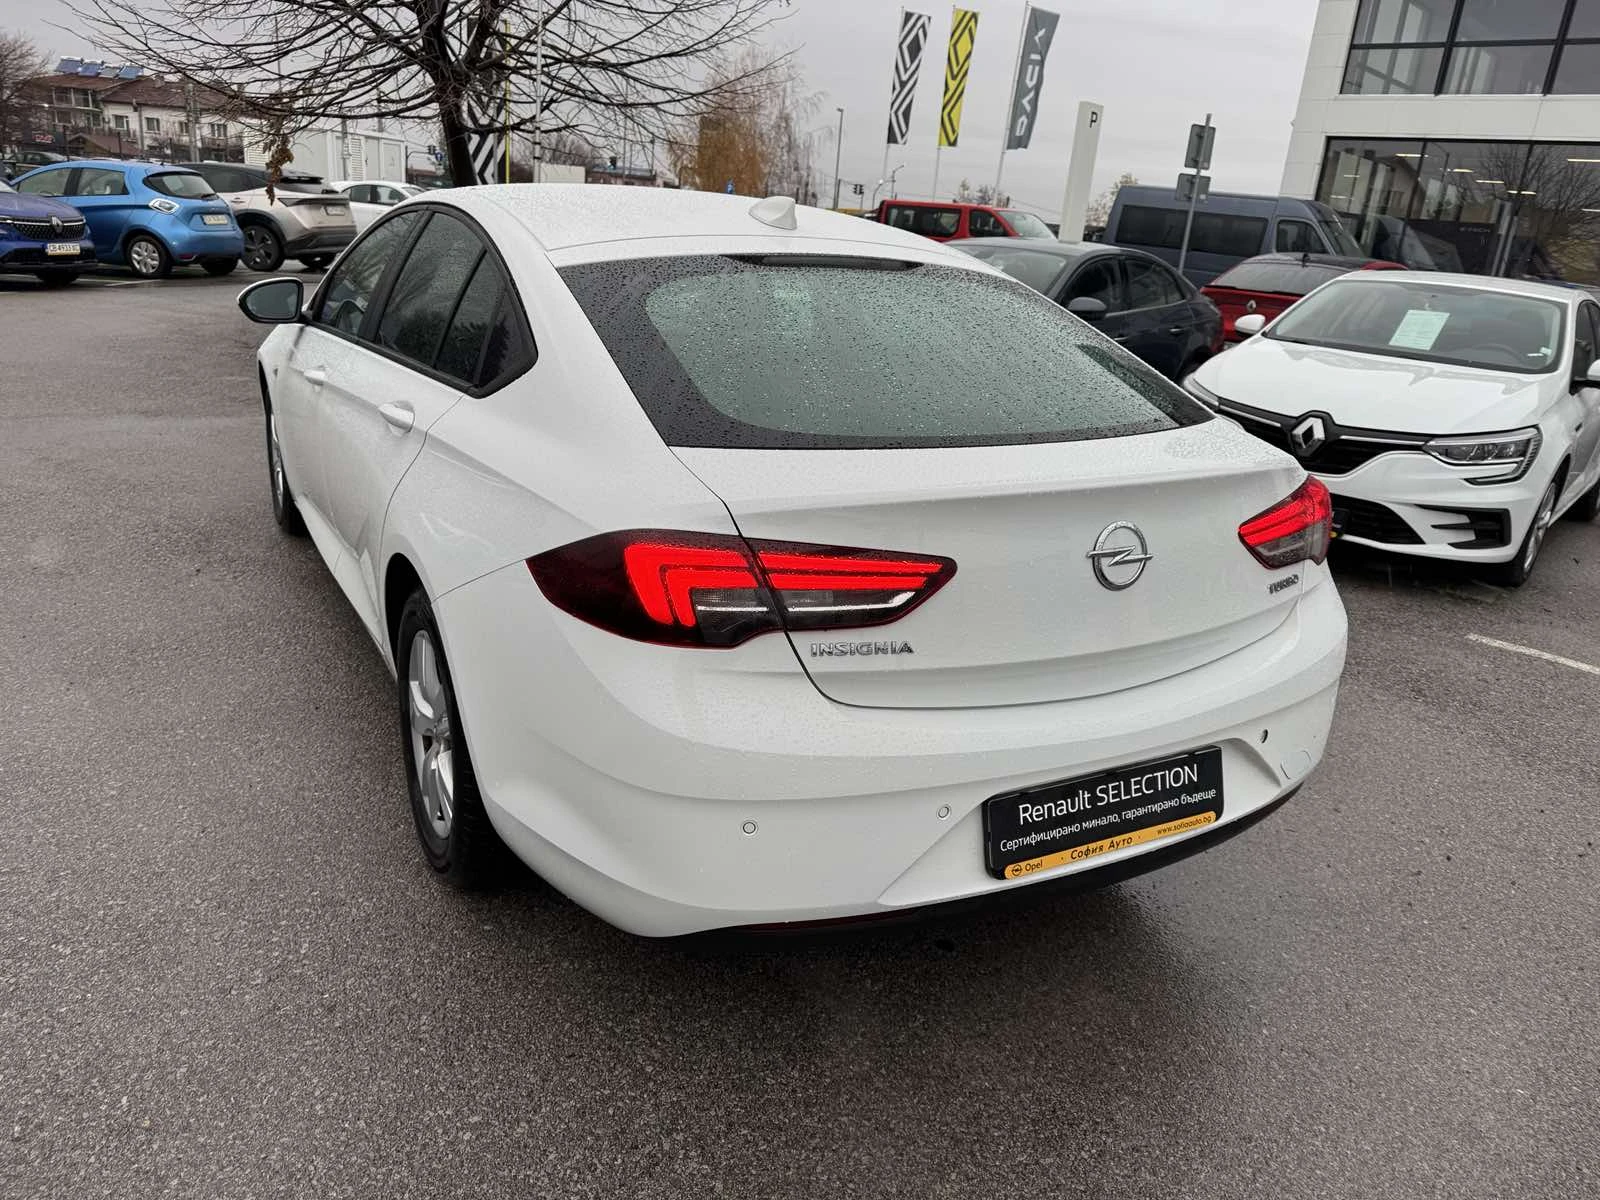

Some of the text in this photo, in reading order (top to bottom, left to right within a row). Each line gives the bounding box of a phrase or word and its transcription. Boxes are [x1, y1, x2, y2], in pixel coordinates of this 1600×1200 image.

[1015, 28, 1046, 137] DACIA
[1089, 111, 1098, 129] P
[810, 640, 914, 657] INSIGNIA
[1018, 763, 1198, 825] Renault SELECTION
[1000, 788, 1217, 852] Сертифицирано минало, гарантирано бъдеще
[1070, 836, 1133, 860] София Ауто
[1024, 860, 1043, 872] Opel
